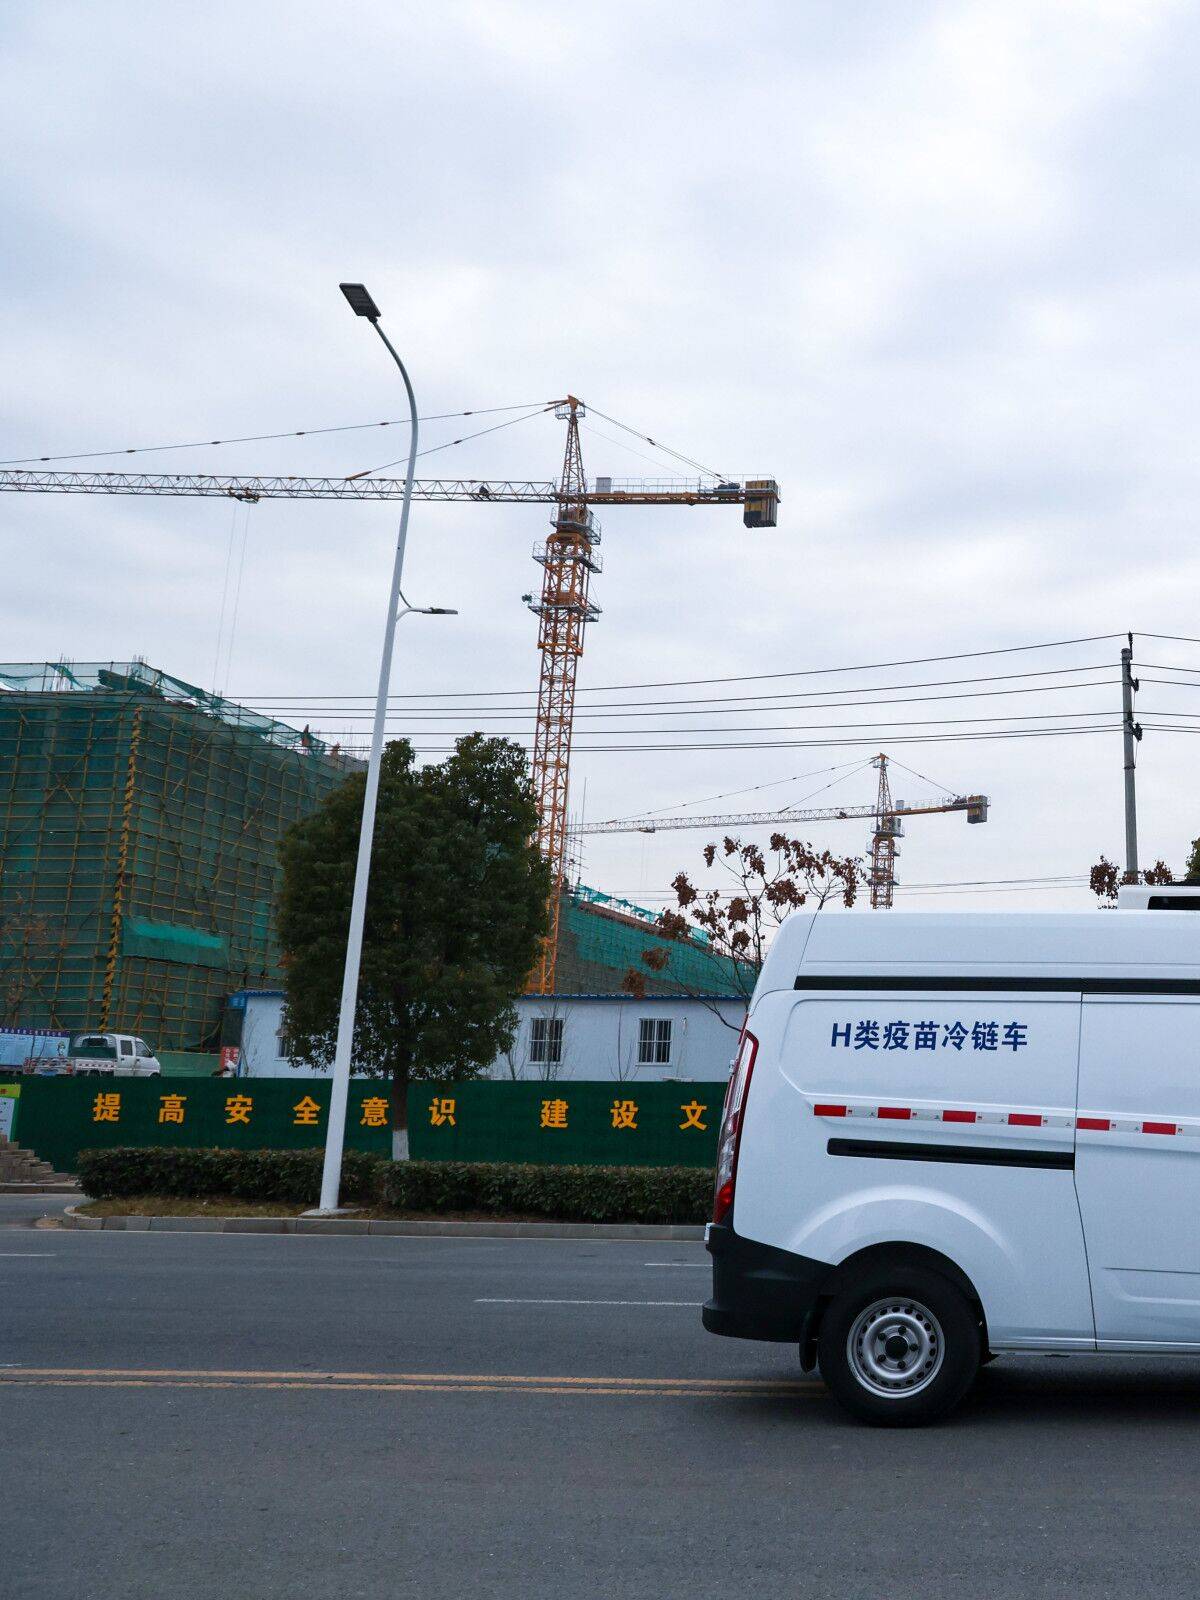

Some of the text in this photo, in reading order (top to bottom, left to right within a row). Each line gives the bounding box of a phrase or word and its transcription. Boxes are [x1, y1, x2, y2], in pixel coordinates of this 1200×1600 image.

[831, 1020, 1028, 1051] H类疫苗冷链车
